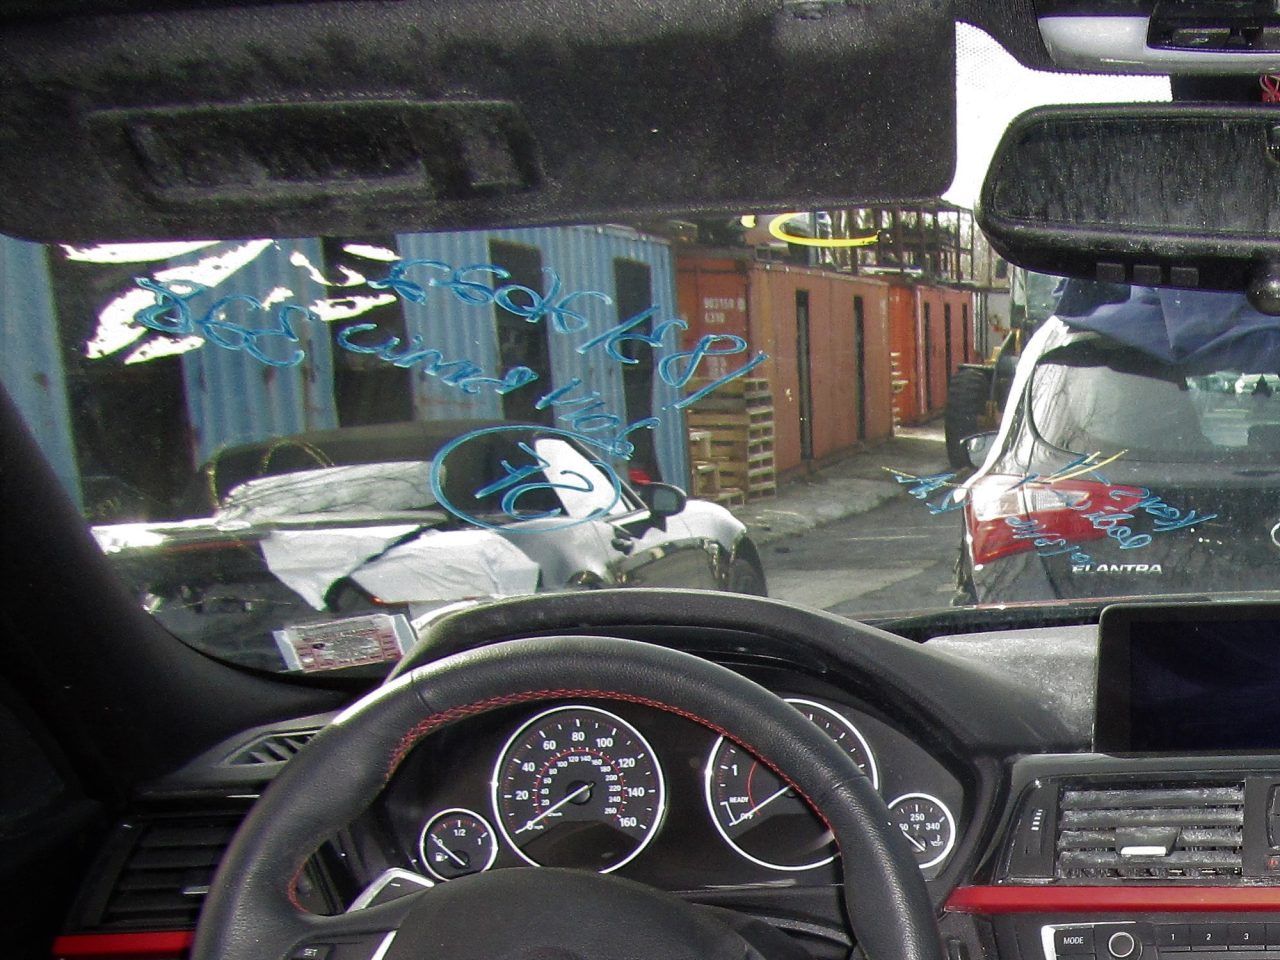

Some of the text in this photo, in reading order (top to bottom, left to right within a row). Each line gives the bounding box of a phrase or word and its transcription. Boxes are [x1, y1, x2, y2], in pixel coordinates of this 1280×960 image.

[1072, 564, 1162, 574] ELANTRA
[572, 732, 585, 742] 80
[543, 741, 556, 750] 60
[597, 738, 613, 747] 100
[522, 762, 535, 772] 40
[618, 758, 635, 768] 120
[731, 764, 738, 776] 1
[515, 791, 528, 800] 20
[628, 787, 645, 797] 140
[910, 813, 925, 821] 250
[620, 817, 637, 827] 160
[925, 822, 940, 831] 340
[454, 829, 466, 837] 1/2
[1063, 936, 1084, 945] MODE
[1171, 932, 1175, 941] 1
[1206, 932, 1212, 941] 2
[1243, 932, 1249, 941] 3
